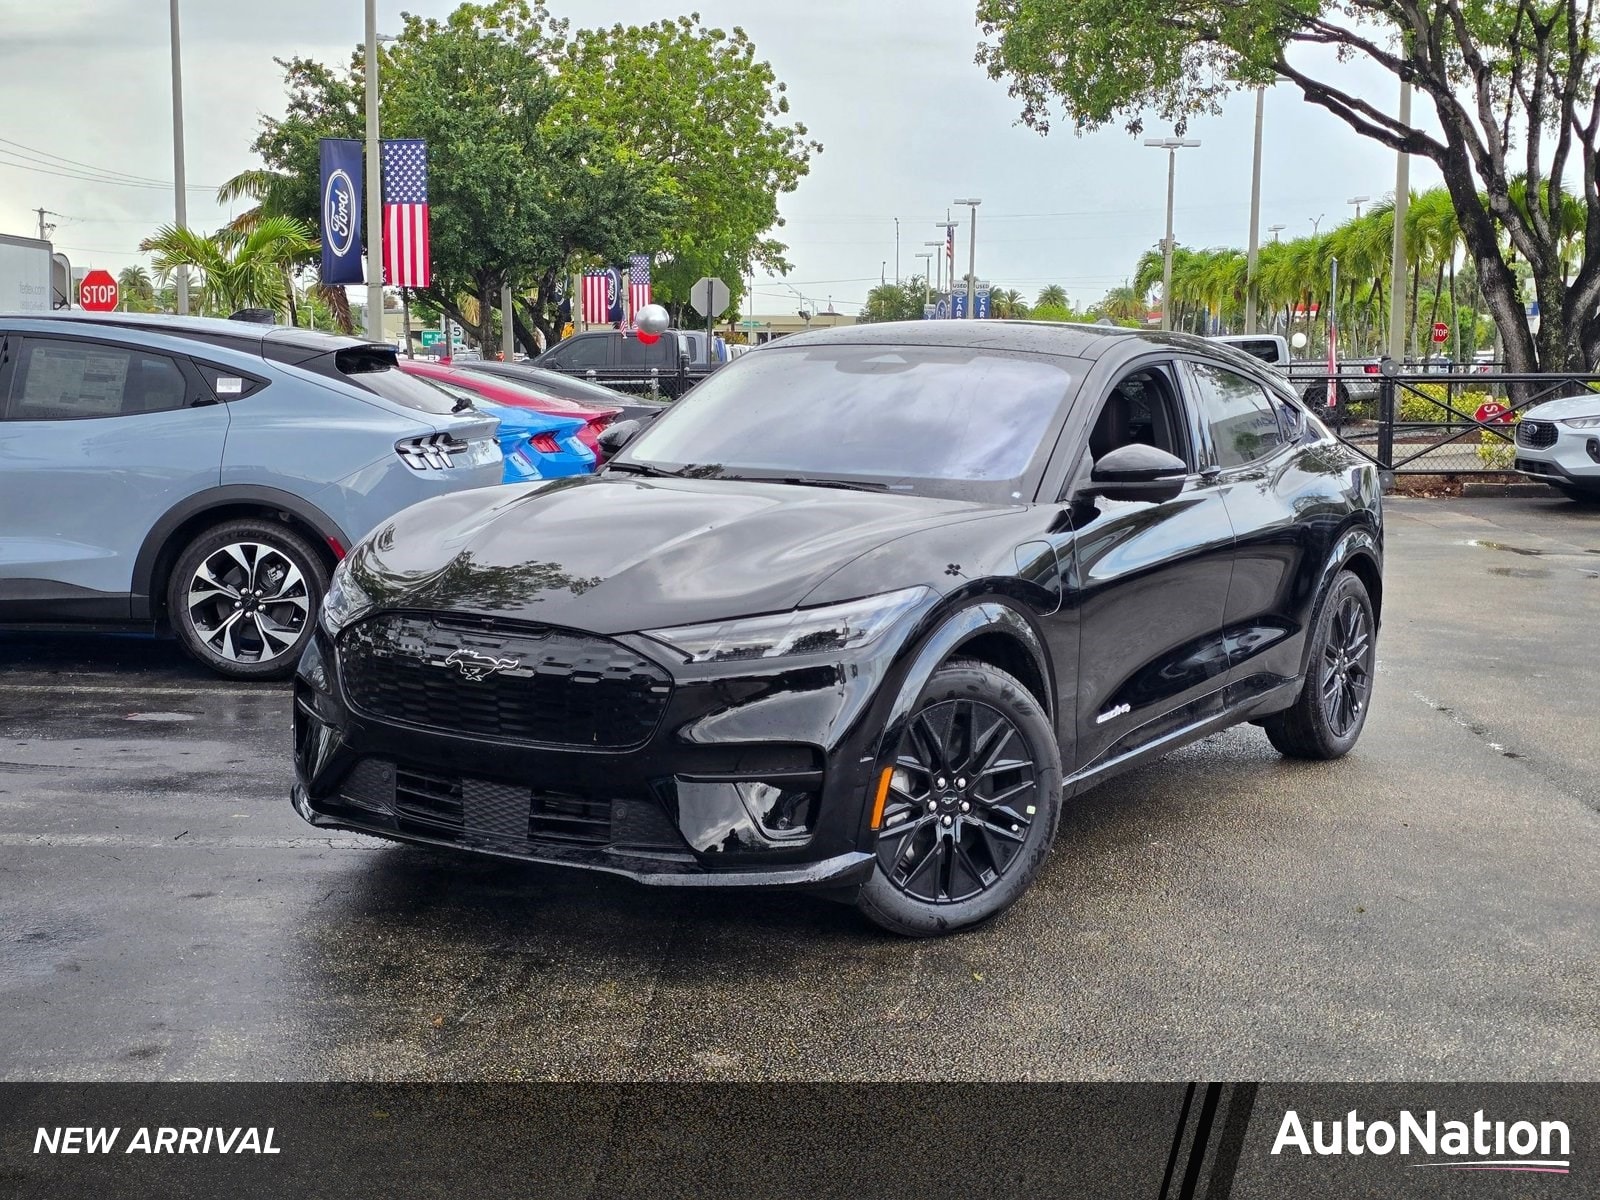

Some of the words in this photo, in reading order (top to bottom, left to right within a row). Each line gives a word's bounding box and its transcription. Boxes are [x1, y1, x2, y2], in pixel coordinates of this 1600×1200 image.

[330, 188, 349, 237] Ford
[82, 285, 117, 304] STOP
[1434, 329, 1448, 337] TOP
